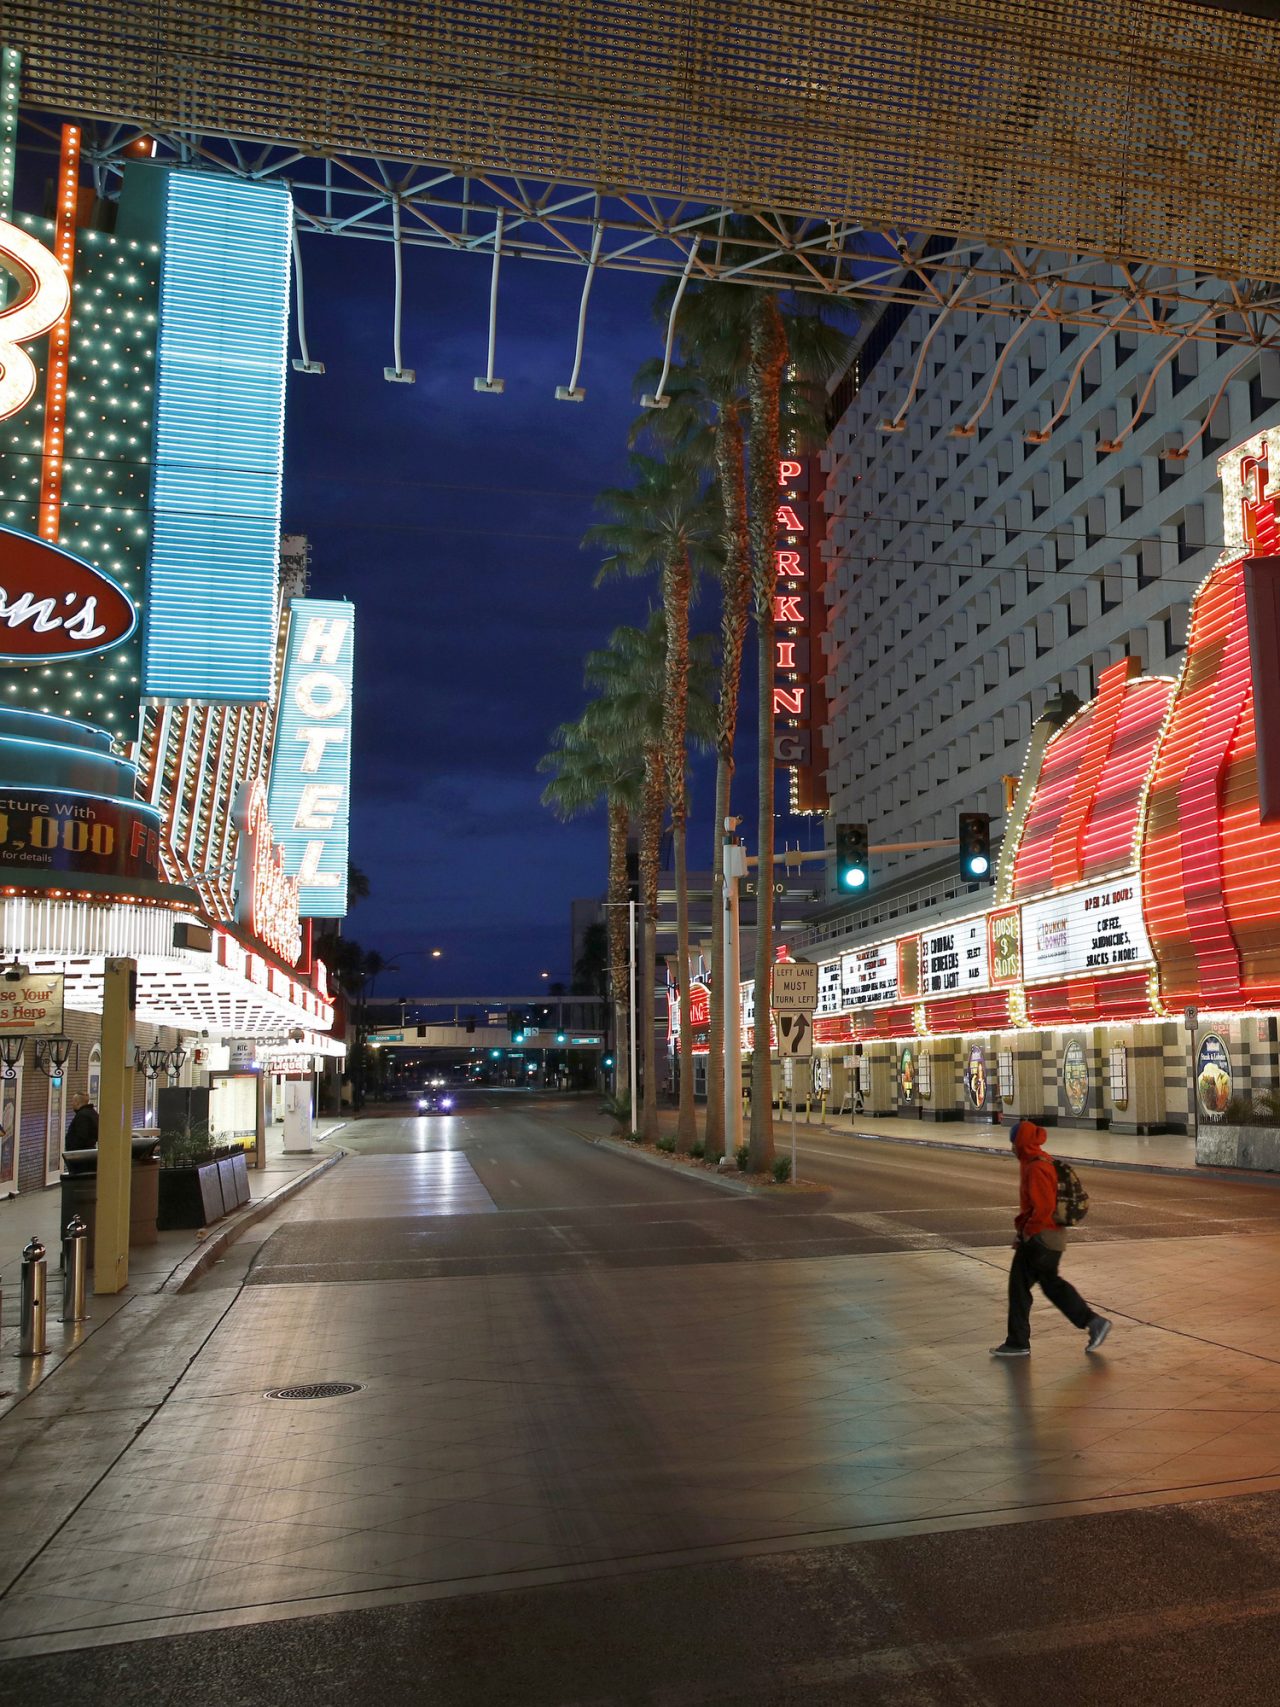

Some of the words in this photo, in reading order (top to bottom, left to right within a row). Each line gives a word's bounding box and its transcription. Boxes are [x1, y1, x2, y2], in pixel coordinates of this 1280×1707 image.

[773, 461, 805, 761] PARKING
[293, 618, 349, 887] HOTEL
[55, 803, 96, 820] With
[2, 850, 16, 860] for
[19, 851, 53, 863] details
[1084, 896, 1100, 911] OPEN
[1101, 893, 1111, 907] 24
[1112, 887, 1133, 904] HOURS
[992, 916, 1017, 942] LOOSE
[776, 969, 793, 977] LEFT
[796, 969, 814, 977] LANE
[994, 953, 1017, 978] SLOTS
[783, 981, 807, 991] MUST
[20, 988, 53, 1001] Your
[775, 995, 794, 1004] TURN
[798, 995, 815, 1004] LEFT
[13, 1005, 46, 1018] Here
